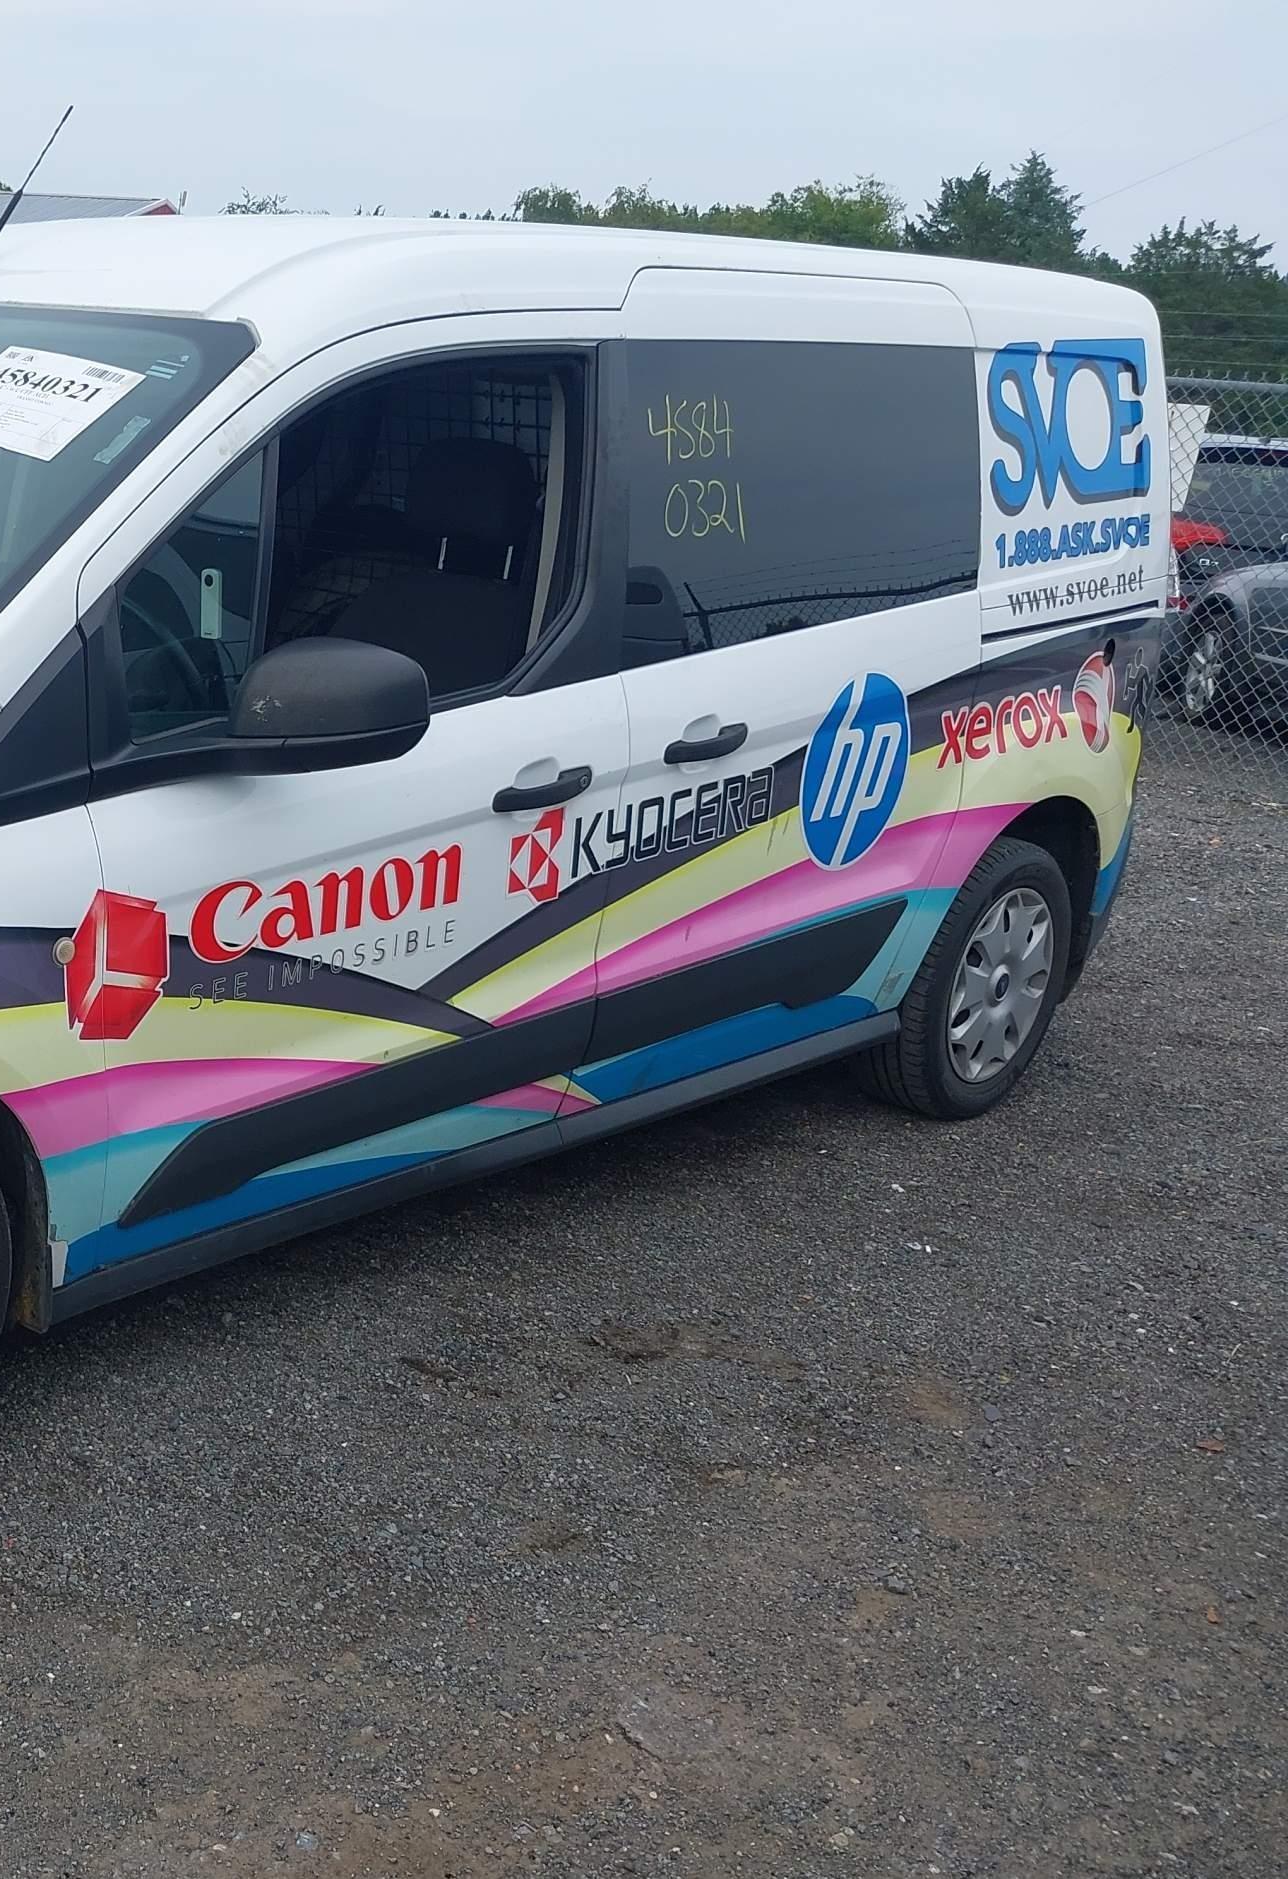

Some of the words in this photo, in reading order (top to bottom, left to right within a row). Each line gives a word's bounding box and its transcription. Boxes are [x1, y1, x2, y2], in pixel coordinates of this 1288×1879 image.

[647, 393, 735, 465] 4584
[987, 338, 1151, 516] SVOE
[664, 479, 746, 545] 0321
[1008, 564, 1144, 616] www.svoe.net
[808, 668, 903, 868] hp
[936, 684, 1068, 772] xerox
[570, 765, 775, 880] KYOCERA
[188, 842, 464, 963] Canon
[188, 971, 249, 1010] SEE
[267, 918, 457, 991] IMPOSSIBLE
